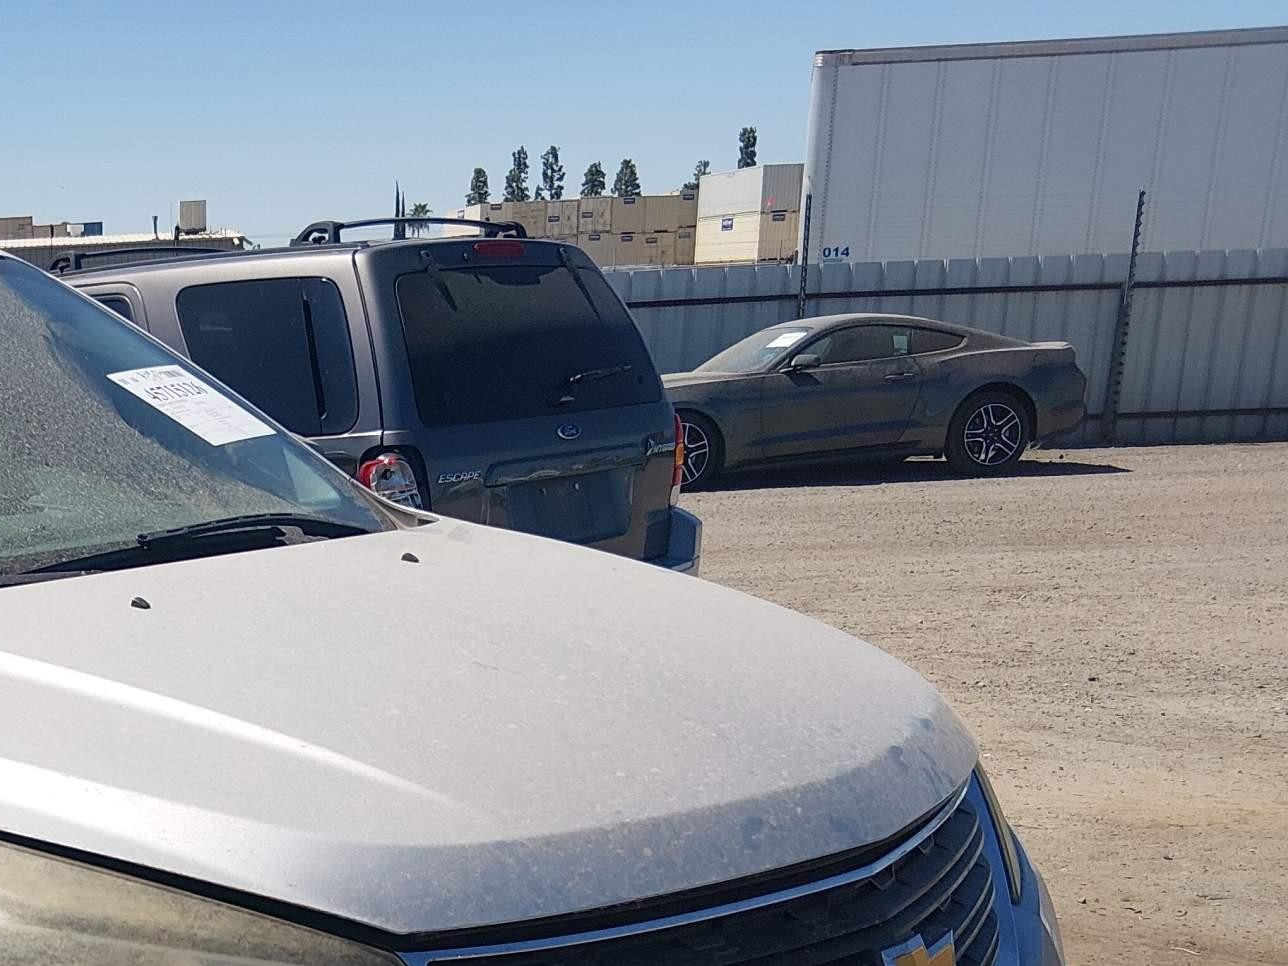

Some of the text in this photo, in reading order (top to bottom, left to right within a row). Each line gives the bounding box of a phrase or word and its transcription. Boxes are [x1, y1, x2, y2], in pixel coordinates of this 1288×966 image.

[822, 246, 850, 258] 014
[143, 380, 209, 402] 45715126
[437, 470, 482, 484] ESCAPE
